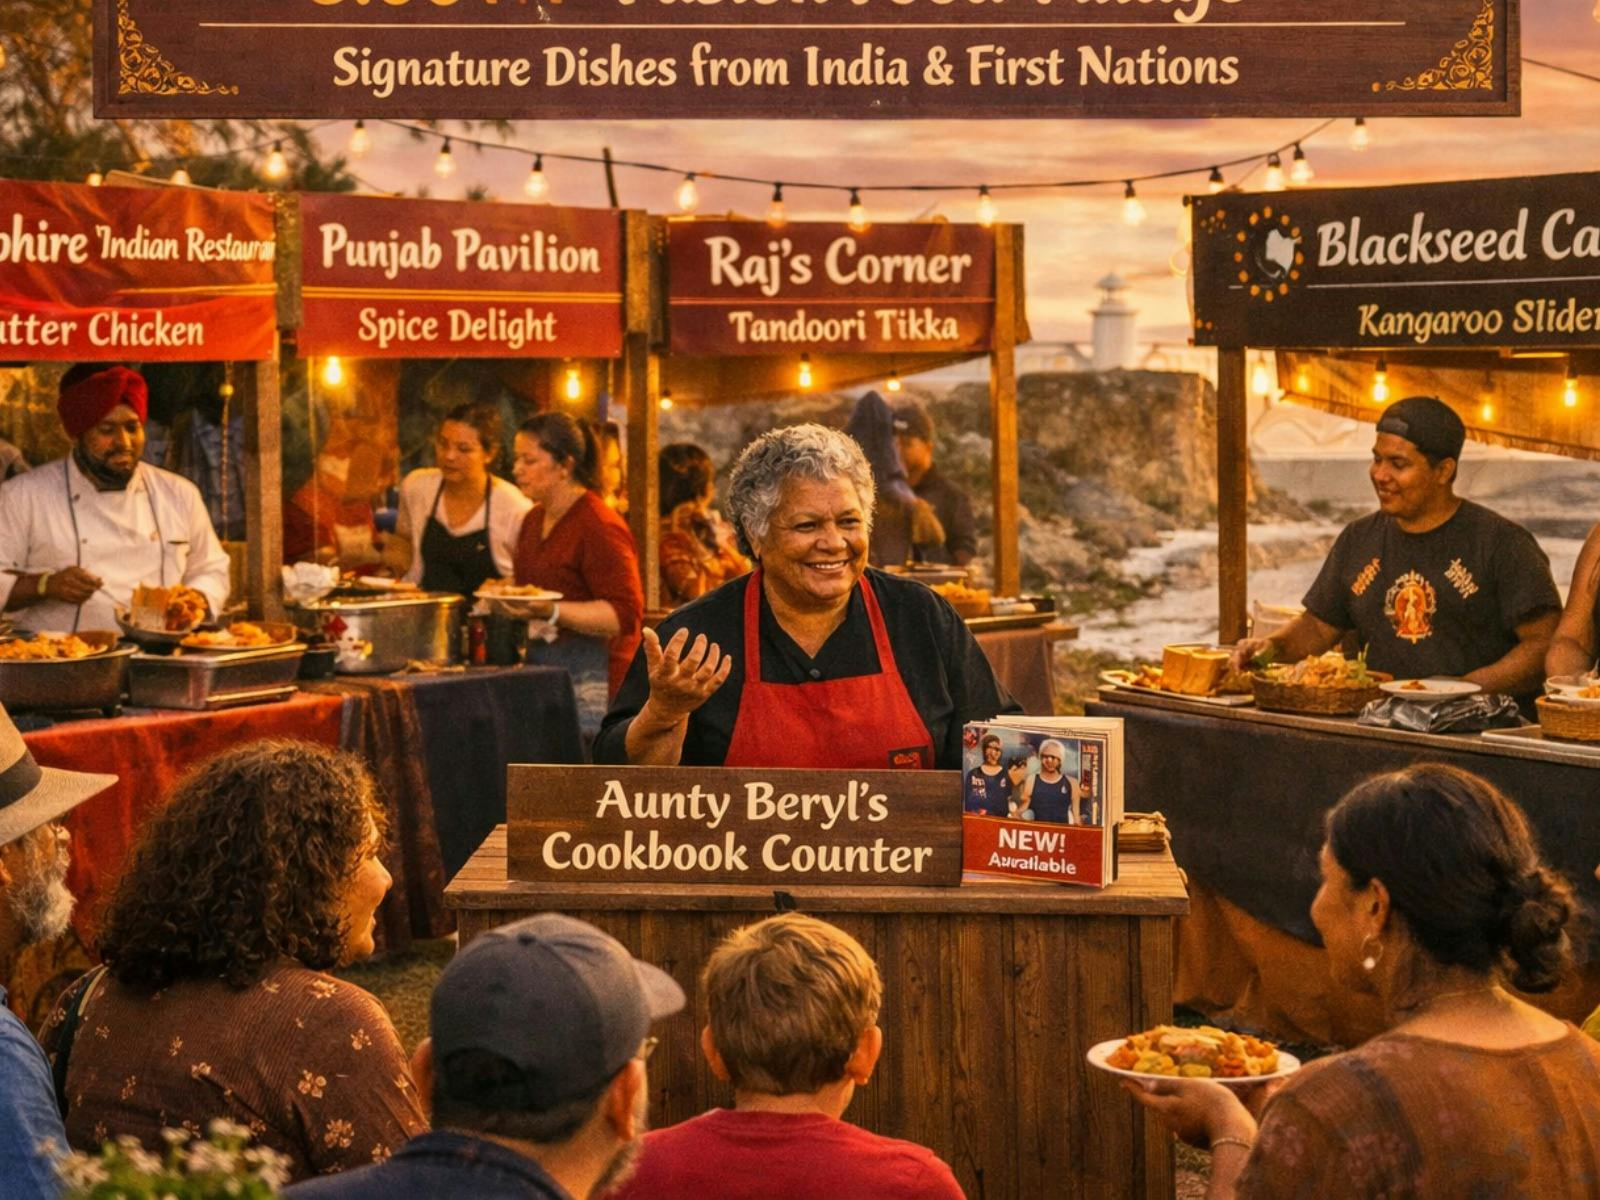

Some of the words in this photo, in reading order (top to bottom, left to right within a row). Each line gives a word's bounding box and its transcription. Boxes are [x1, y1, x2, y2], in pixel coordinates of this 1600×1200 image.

[333, 46, 531, 98] Signature
[542, 42, 677, 87] Dishes
[689, 41, 790, 87] from
[803, 42, 910, 86] India
[922, 45, 955, 86] &
[966, 44, 1065, 86] First
[1077, 44, 1239, 86] Nations
[95, 224, 180, 260] Indian
[319, 222, 443, 280] Punjab
[451, 227, 601, 273] Pavilion
[1317, 207, 1529, 267] Blackseed
[704, 236, 813, 297] Raj's
[825, 236, 972, 285] Corner
[88, 309, 204, 347] Chicken
[358, 307, 438, 349] Spice
[447, 307, 557, 350] Delight
[728, 309, 867, 343] Tandoori
[874, 307, 960, 341] Tikka
[1358, 303, 1504, 345] Kangaroo
[595, 779, 731, 829] Aunty
[743, 779, 889, 830] Beryl's
[542, 829, 749, 871] Cookbook
[761, 833, 933, 874] Counter
[998, 827, 1066, 853] NEW!
